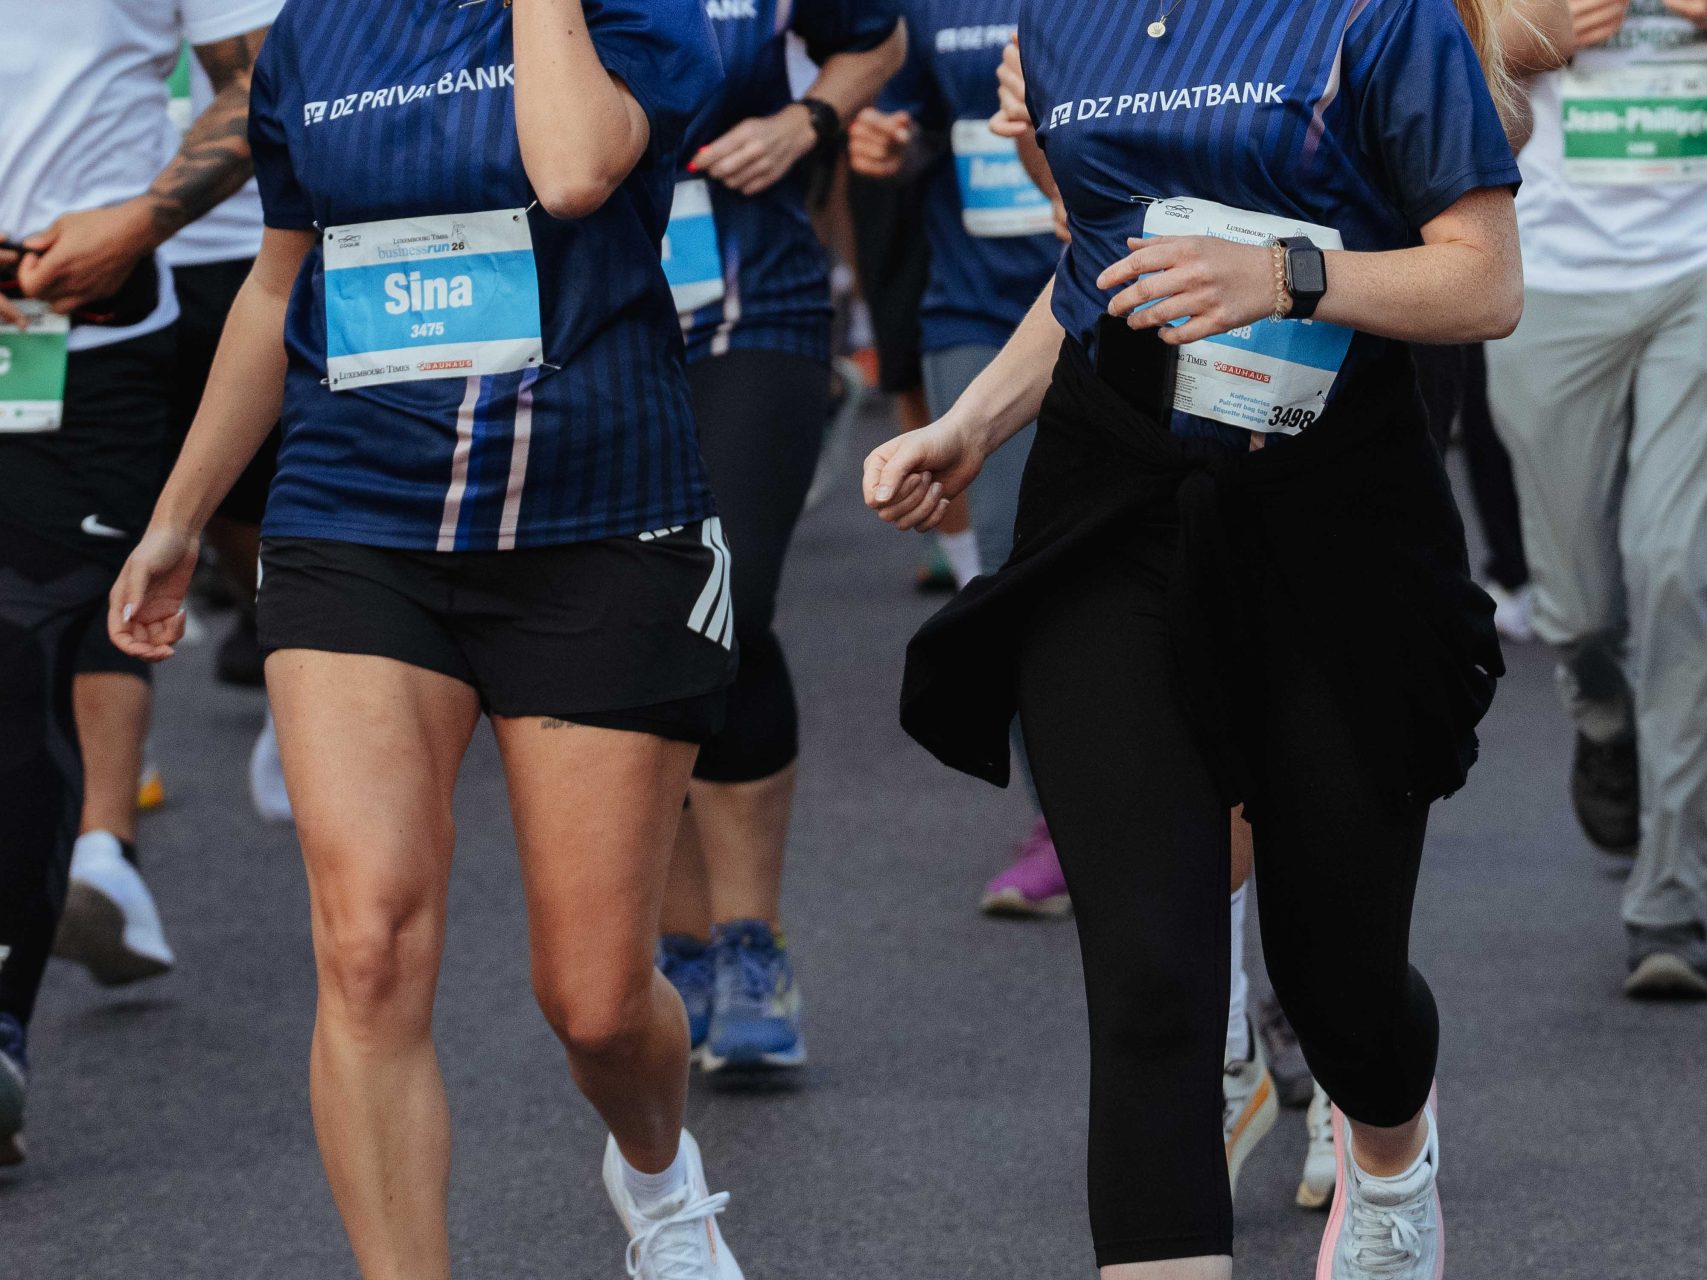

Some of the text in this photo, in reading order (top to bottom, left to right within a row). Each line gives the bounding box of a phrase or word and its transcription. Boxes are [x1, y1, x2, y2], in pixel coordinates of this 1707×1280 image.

[330, 63, 515, 120] DZ PRIVATBANK
[1077, 81, 1286, 120] DZ PRIVATBANK
[1164, 210, 1190, 220] COQUE
[451, 241, 465, 251] 26
[384, 271, 473, 315] Sina
[410, 322, 445, 338] 3475
[425, 360, 472, 370] BAUHAUS
[1186, 354, 1208, 367] TIMES
[339, 364, 410, 381] LUXEMBOURG TIMES
[1221, 363, 1271, 383] BAUHAUS
[1268, 405, 1316, 430] 3498
